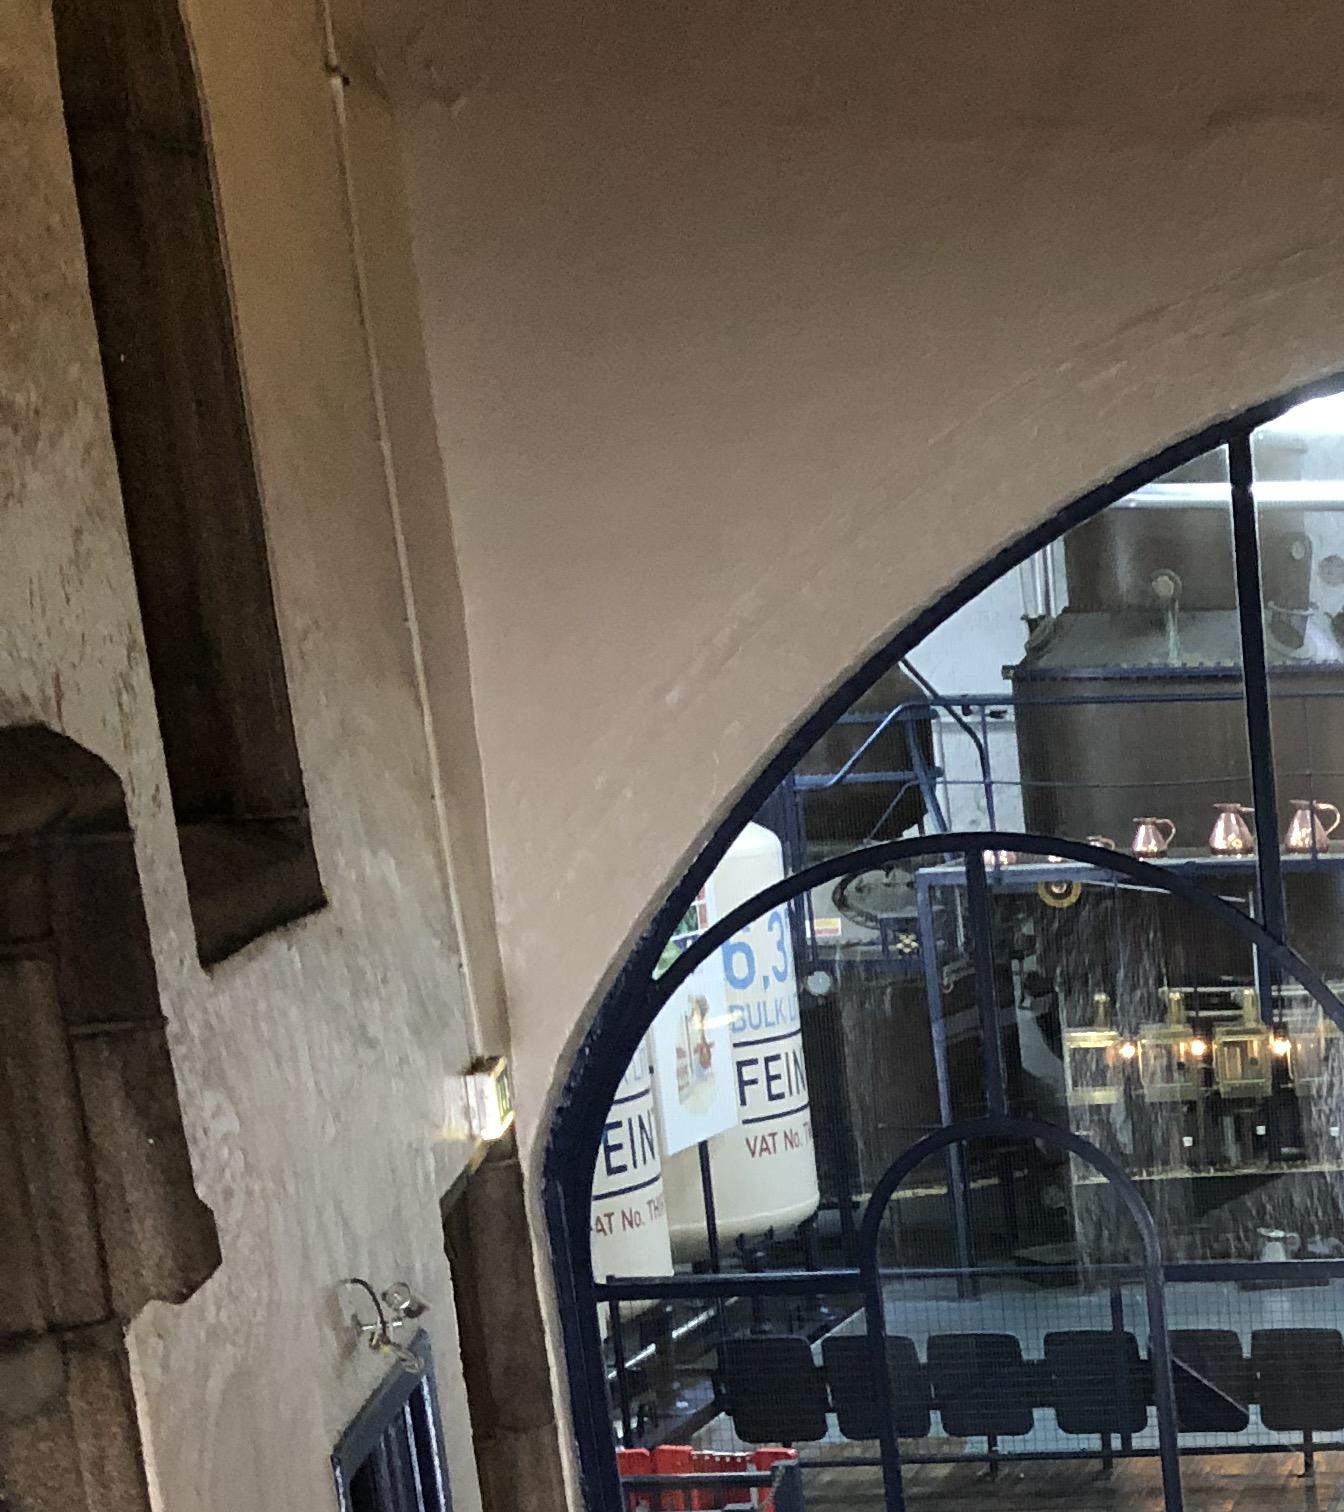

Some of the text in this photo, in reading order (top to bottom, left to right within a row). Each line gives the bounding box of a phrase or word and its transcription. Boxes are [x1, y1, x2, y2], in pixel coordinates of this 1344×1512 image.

[729, 998, 786, 1034] BULK
[601, 1109, 655, 1176] EIN
[745, 1132, 778, 1158] VAT
[592, 1211, 615, 1236] AT
